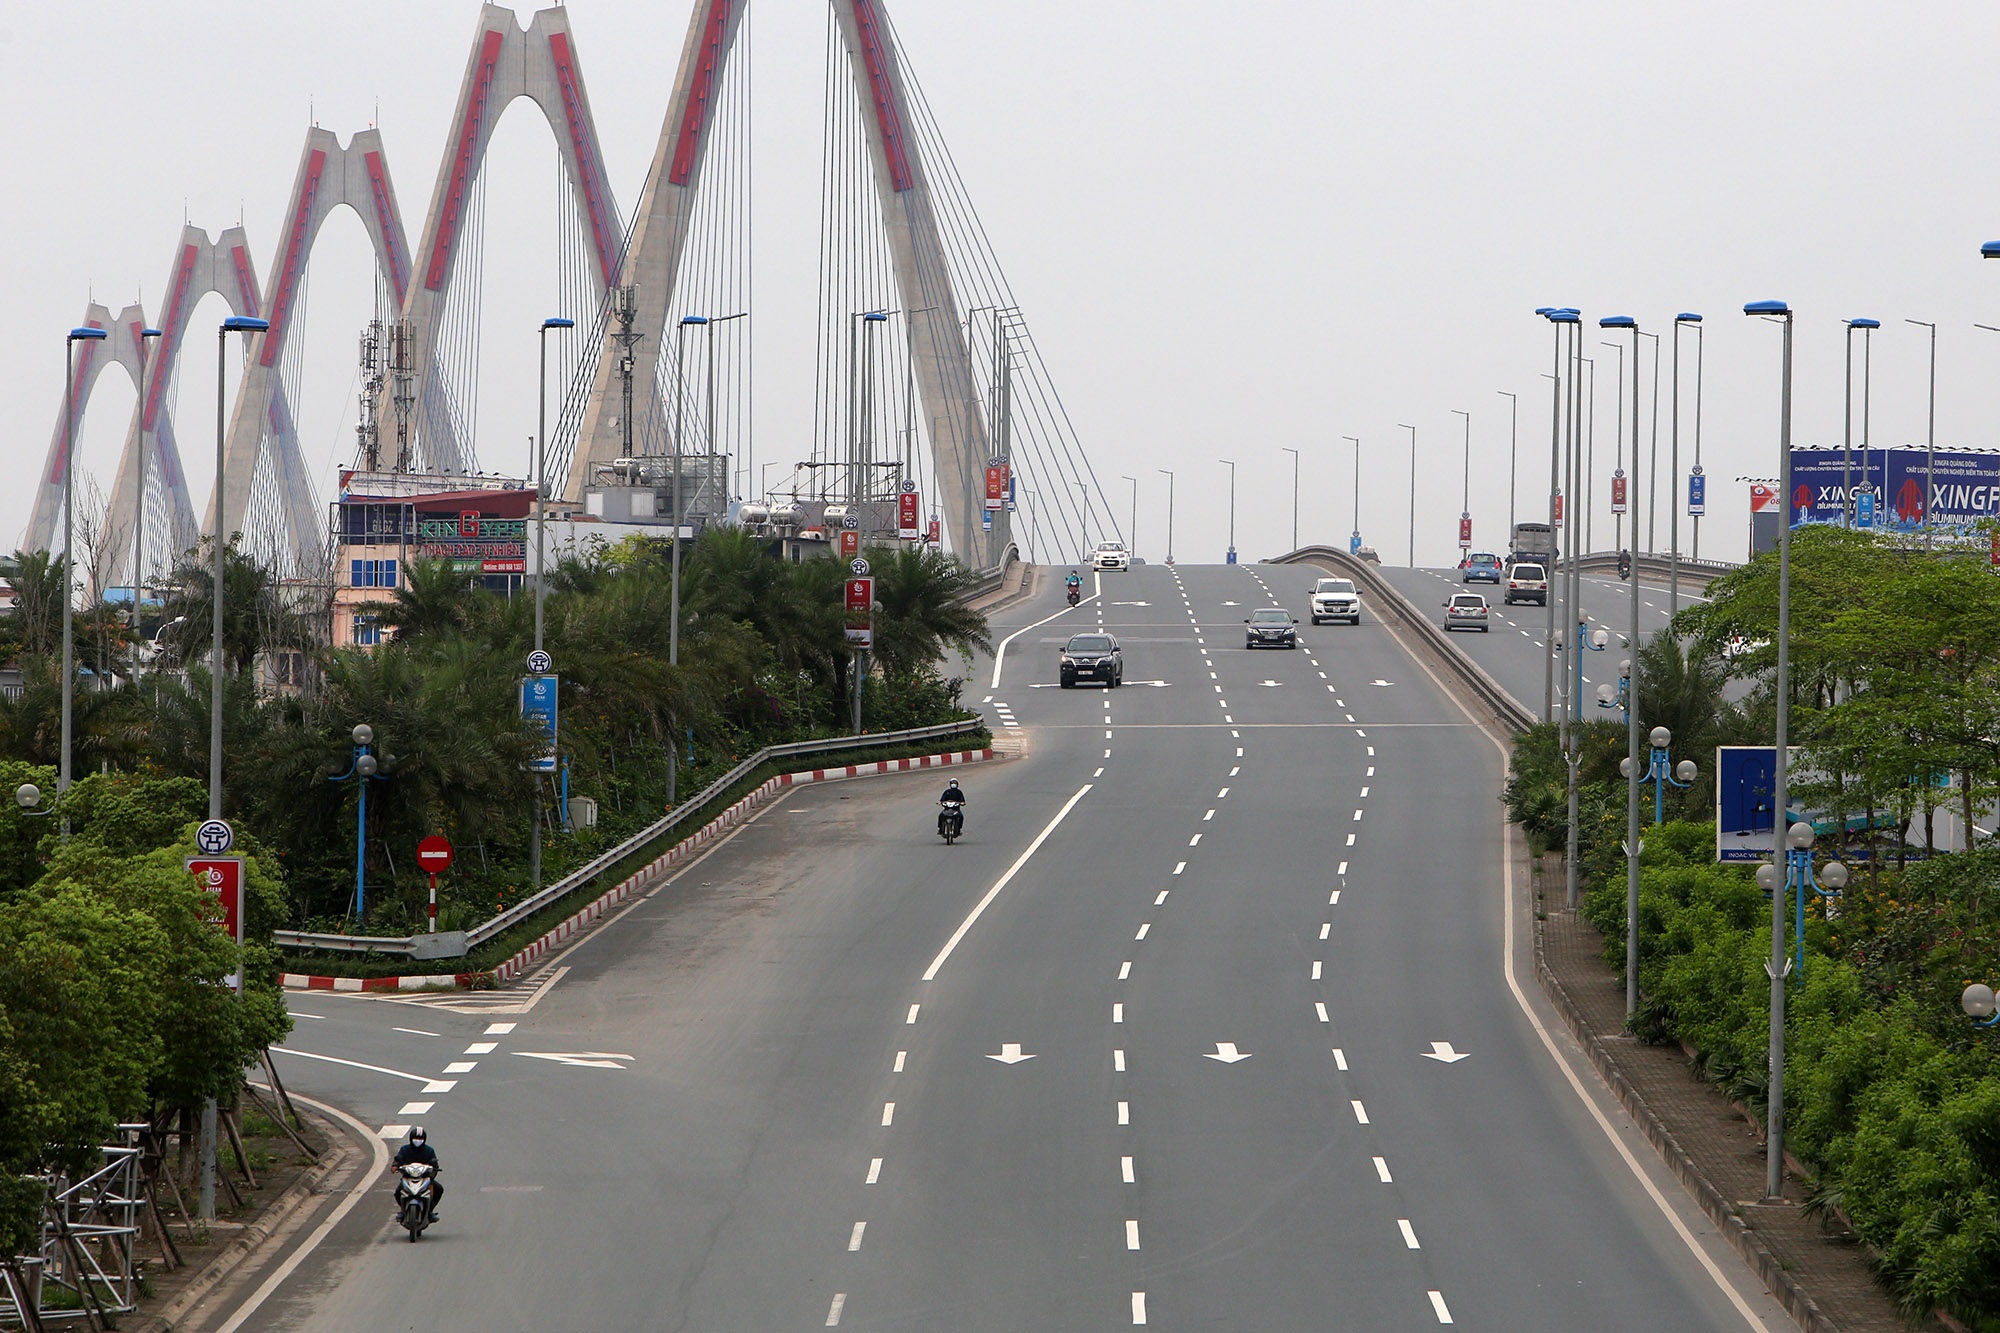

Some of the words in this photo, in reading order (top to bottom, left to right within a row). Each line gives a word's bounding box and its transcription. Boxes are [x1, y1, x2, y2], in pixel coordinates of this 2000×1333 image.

[1931, 484, 2000, 510] XINGF
[422, 510, 524, 537] KINGYPS
[457, 544, 476, 557] CAO
